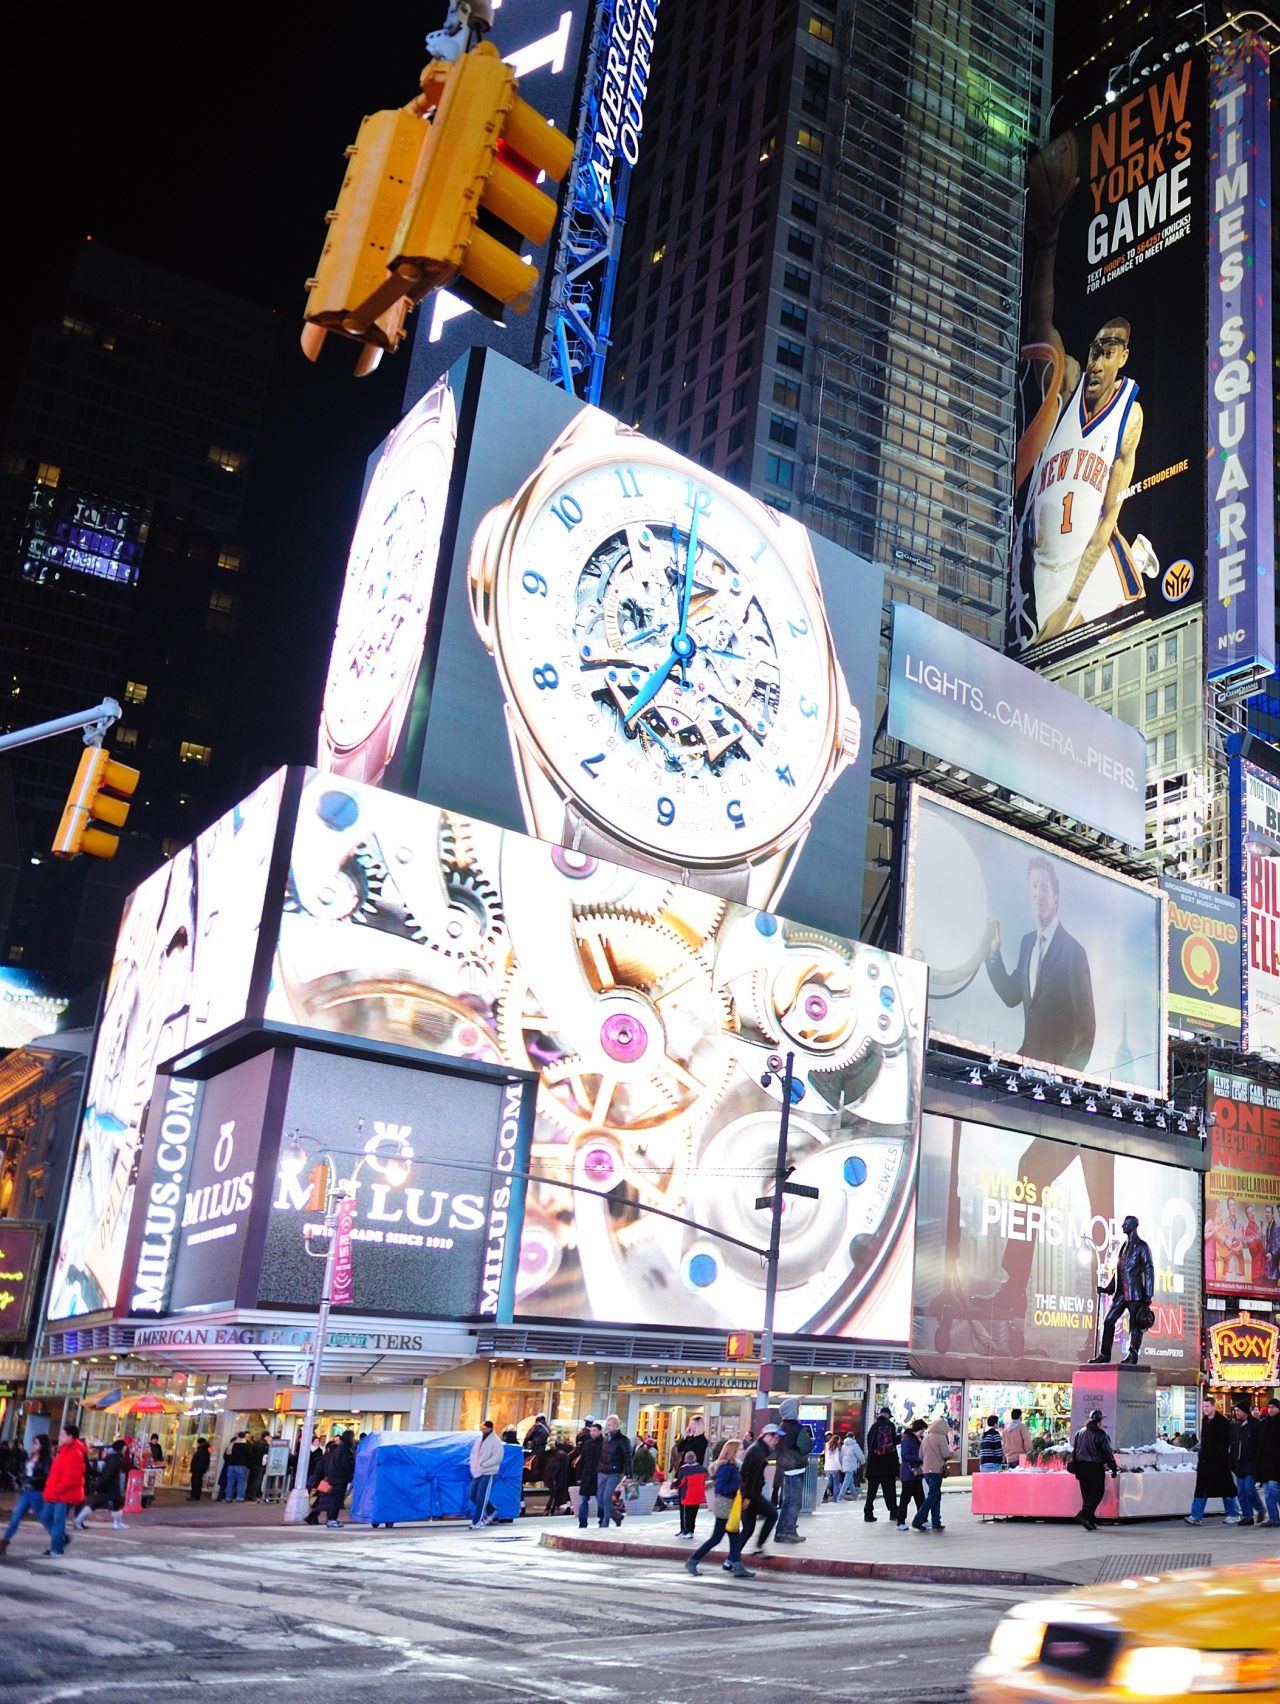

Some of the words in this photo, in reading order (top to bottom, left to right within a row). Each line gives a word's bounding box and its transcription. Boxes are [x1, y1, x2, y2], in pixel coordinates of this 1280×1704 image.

[591, 0, 637, 203] AMERIC
[1089, 60, 1192, 180] NEW
[1090, 120, 1193, 214] YORK'S
[1214, 84, 1249, 293] TIMES
[1087, 157, 1192, 265] GAME
[1086, 279, 1100, 295] FOR
[1100, 276, 1106, 286] A
[1106, 258, 1135, 282] CHANCE
[1134, 254, 1144, 267] TO
[1144, 240, 1164, 260] MEET
[1164, 224, 1192, 248] AMAR'E
[1087, 267, 1103, 284] TEXT
[1103, 253, 1126, 275] HOOPS
[1127, 247, 1136, 261] TO
[1161, 213, 1192, 239] (KNICKS)
[1037, 448, 1075, 497] NEW
[1072, 449, 1111, 494] YORK
[1142, 458, 1189, 491] STOUDEMIRE
[1213, 314, 1252, 601] SQUARE
[615, 465, 644, 499] 11
[550, 493, 583, 533] 10
[1060, 491, 1075, 535] 1
[522, 569, 549, 598] 9
[787, 617, 809, 638] 2
[1218, 628, 1246, 650] NYC
[532, 662, 560, 690] 8
[799, 693, 819, 720] 3
[580, 752, 606, 779] 7
[775, 763, 796, 788] 4
[726, 799, 746, 831] 5
[1180, 893, 1196, 904] BEST
[1196, 897, 1221, 912] MUSICAL
[1167, 900, 1238, 945] Avenue
[1180, 932, 1220, 997] Q
[1213, 1075, 1230, 1089] ELVIS
[1232, 1087, 1248, 1103] LEWIS
[1249, 1083, 1265, 1098] CARL
[1266, 1095, 1280, 1110] CASH
[131, 1077, 198, 1314] MILUS.COM
[181, 1170, 255, 1229] MILUS
[479, 1082, 524, 1316] MILUS.COM
[980, 1168, 1037, 1205] Who's
[981, 1197, 1064, 1248] PIERS
[1033, 1311, 1079, 1328] COMING
[1081, 1314, 1093, 1329] IN
[1034, 1293, 1056, 1310] THE
[1058, 1294, 1085, 1313] NEW
[1086, 1298, 1094, 1314] 9
[136, 1328, 210, 1347] AMERICAN
[215, 1328, 285, 1347] EAGLE
[1217, 1330, 1271, 1358] ROXY
[132, 1363, 165, 1374] aerie
[641, 1373, 694, 1387] AMERICAN
[696, 1375, 725, 1388] EAGLE
